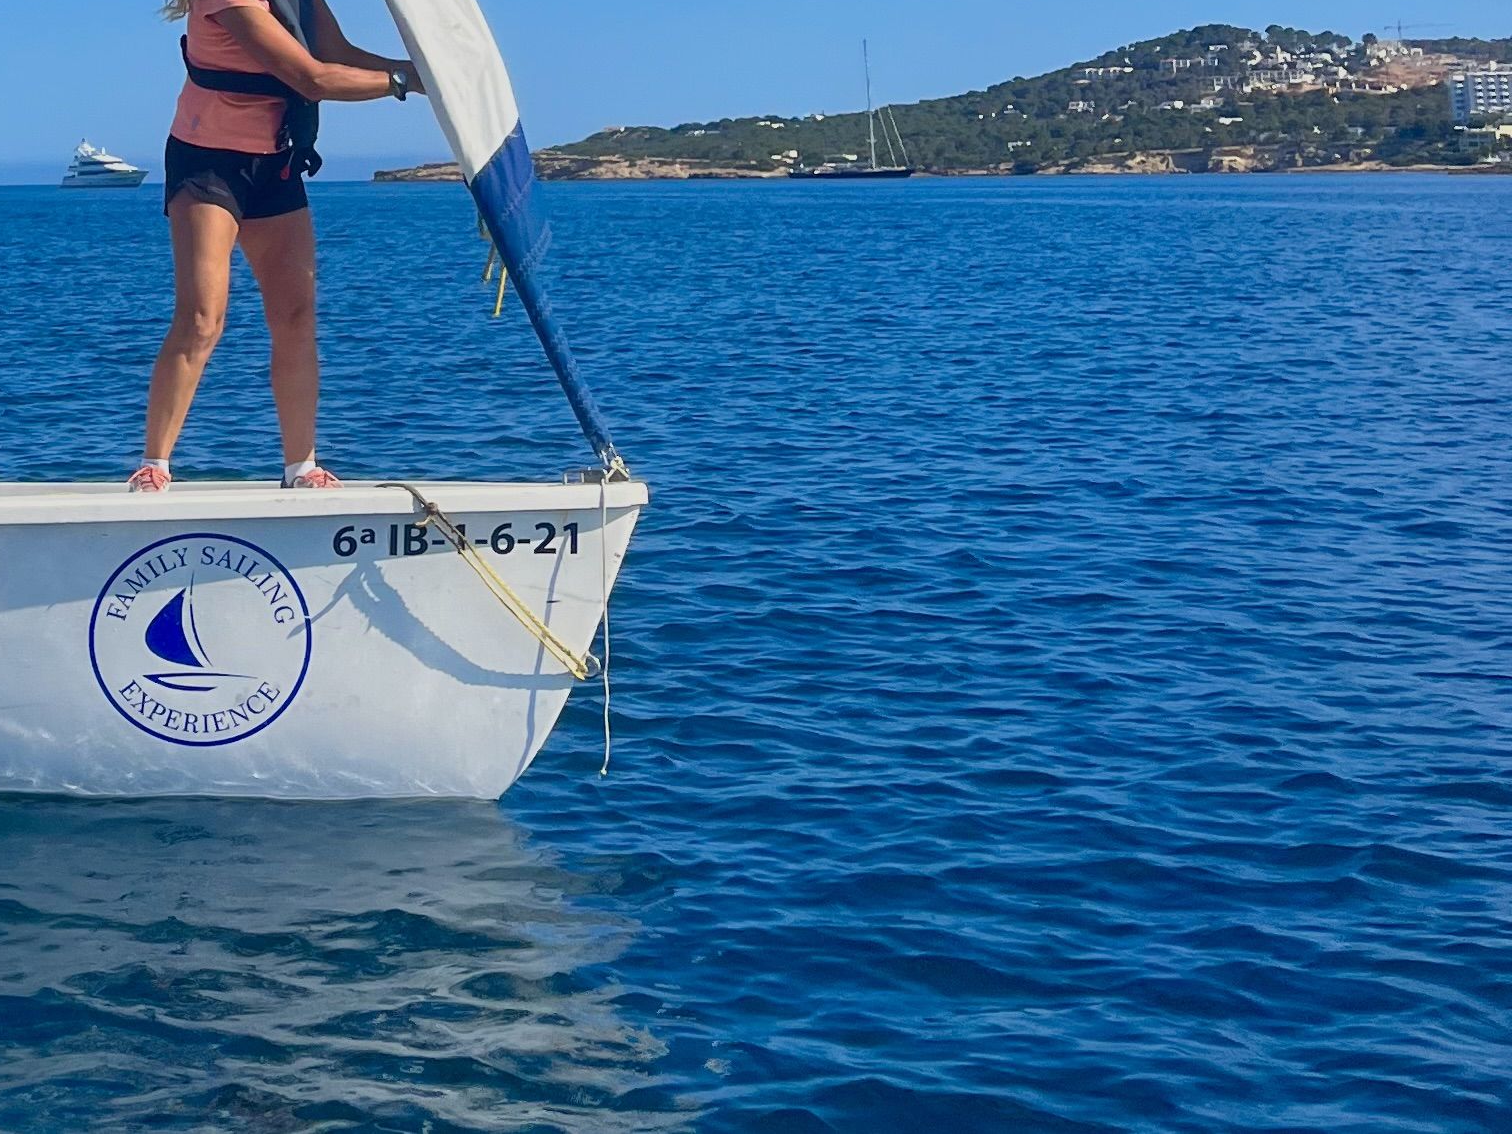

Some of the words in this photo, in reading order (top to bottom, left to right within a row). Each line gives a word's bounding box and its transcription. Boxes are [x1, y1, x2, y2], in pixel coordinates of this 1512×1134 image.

[106, 547, 188, 622] FAMILY
[200, 546, 295, 625] SAILING
[118, 679, 281, 734] EXPERIENCE
